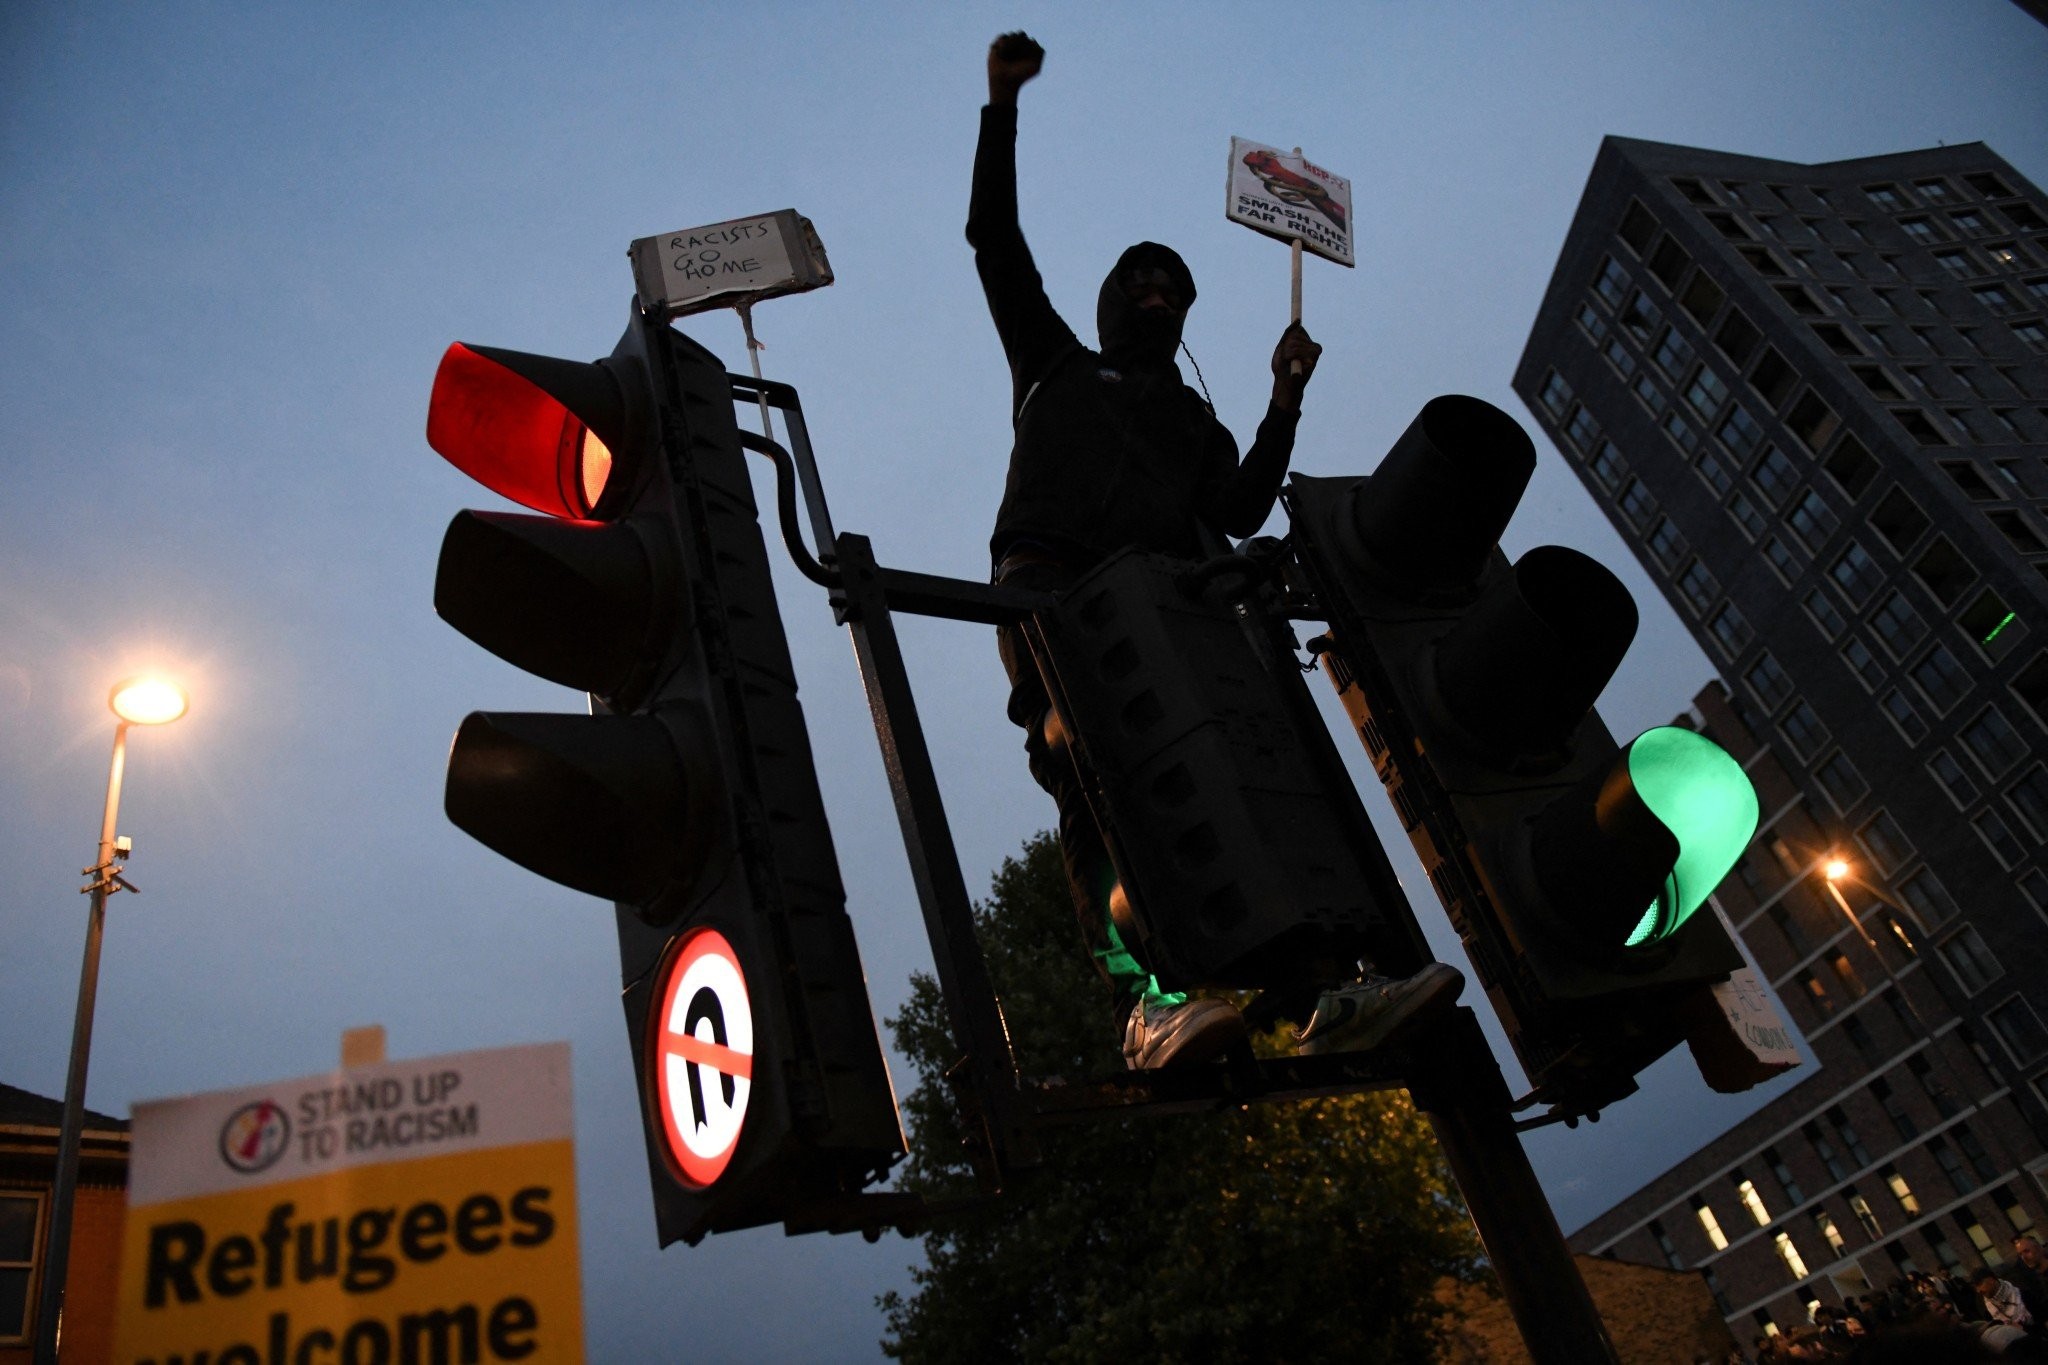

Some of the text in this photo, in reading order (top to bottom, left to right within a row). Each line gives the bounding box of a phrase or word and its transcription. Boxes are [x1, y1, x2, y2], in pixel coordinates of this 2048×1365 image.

[671, 223, 768, 249] RACISTS
[1237, 205, 1276, 224] FAR
[1239, 196, 1310, 225] SMASH
[1312, 220, 1348, 246] THE
[674, 249, 720, 270] GO
[686, 258, 762, 280] HOME
[299, 1070, 460, 1127] STAND UP
[298, 1103, 479, 1163] TO RACISM
[143, 1185, 557, 1310] Refugees
[134, 1296, 538, 1365] lcome
